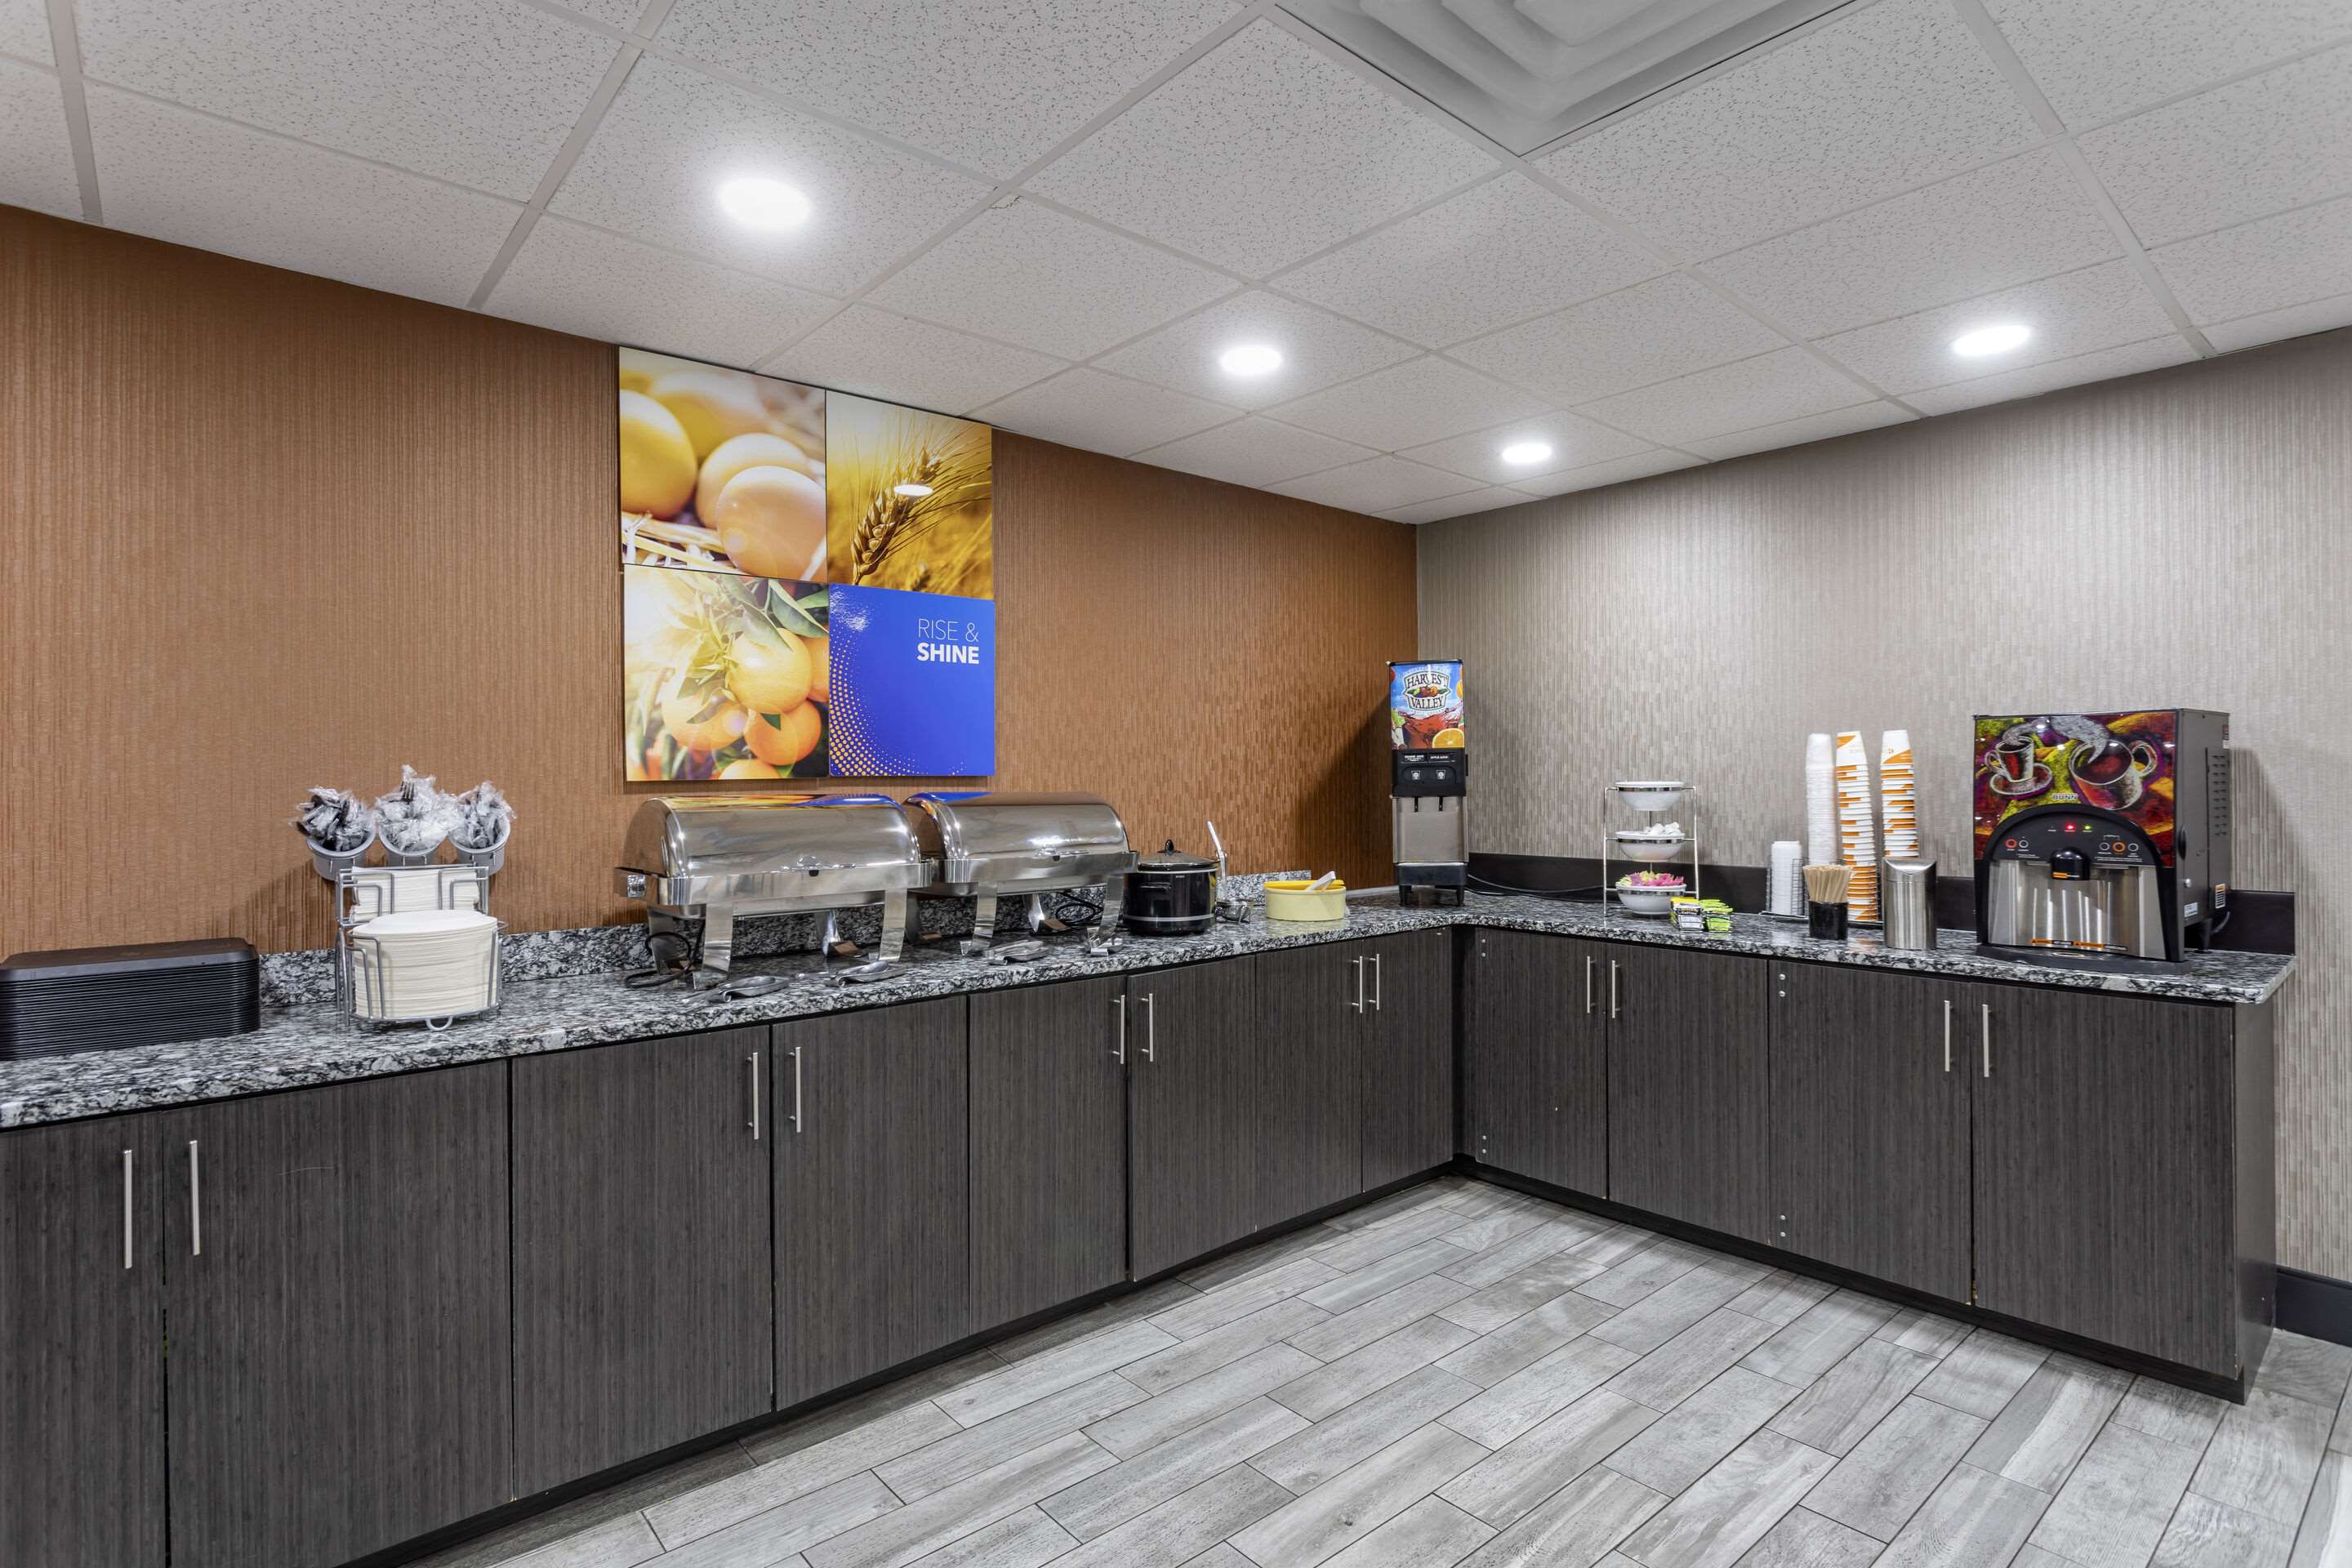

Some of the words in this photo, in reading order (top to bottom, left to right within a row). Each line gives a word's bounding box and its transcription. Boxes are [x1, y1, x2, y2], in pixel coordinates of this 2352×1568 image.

[918, 618, 959, 641] RISE
[965, 622, 979, 643] &
[916, 642, 980, 665] SHINE
[1406, 673, 1448, 688] HARVEST
[1410, 696, 1443, 709] VALLEY
